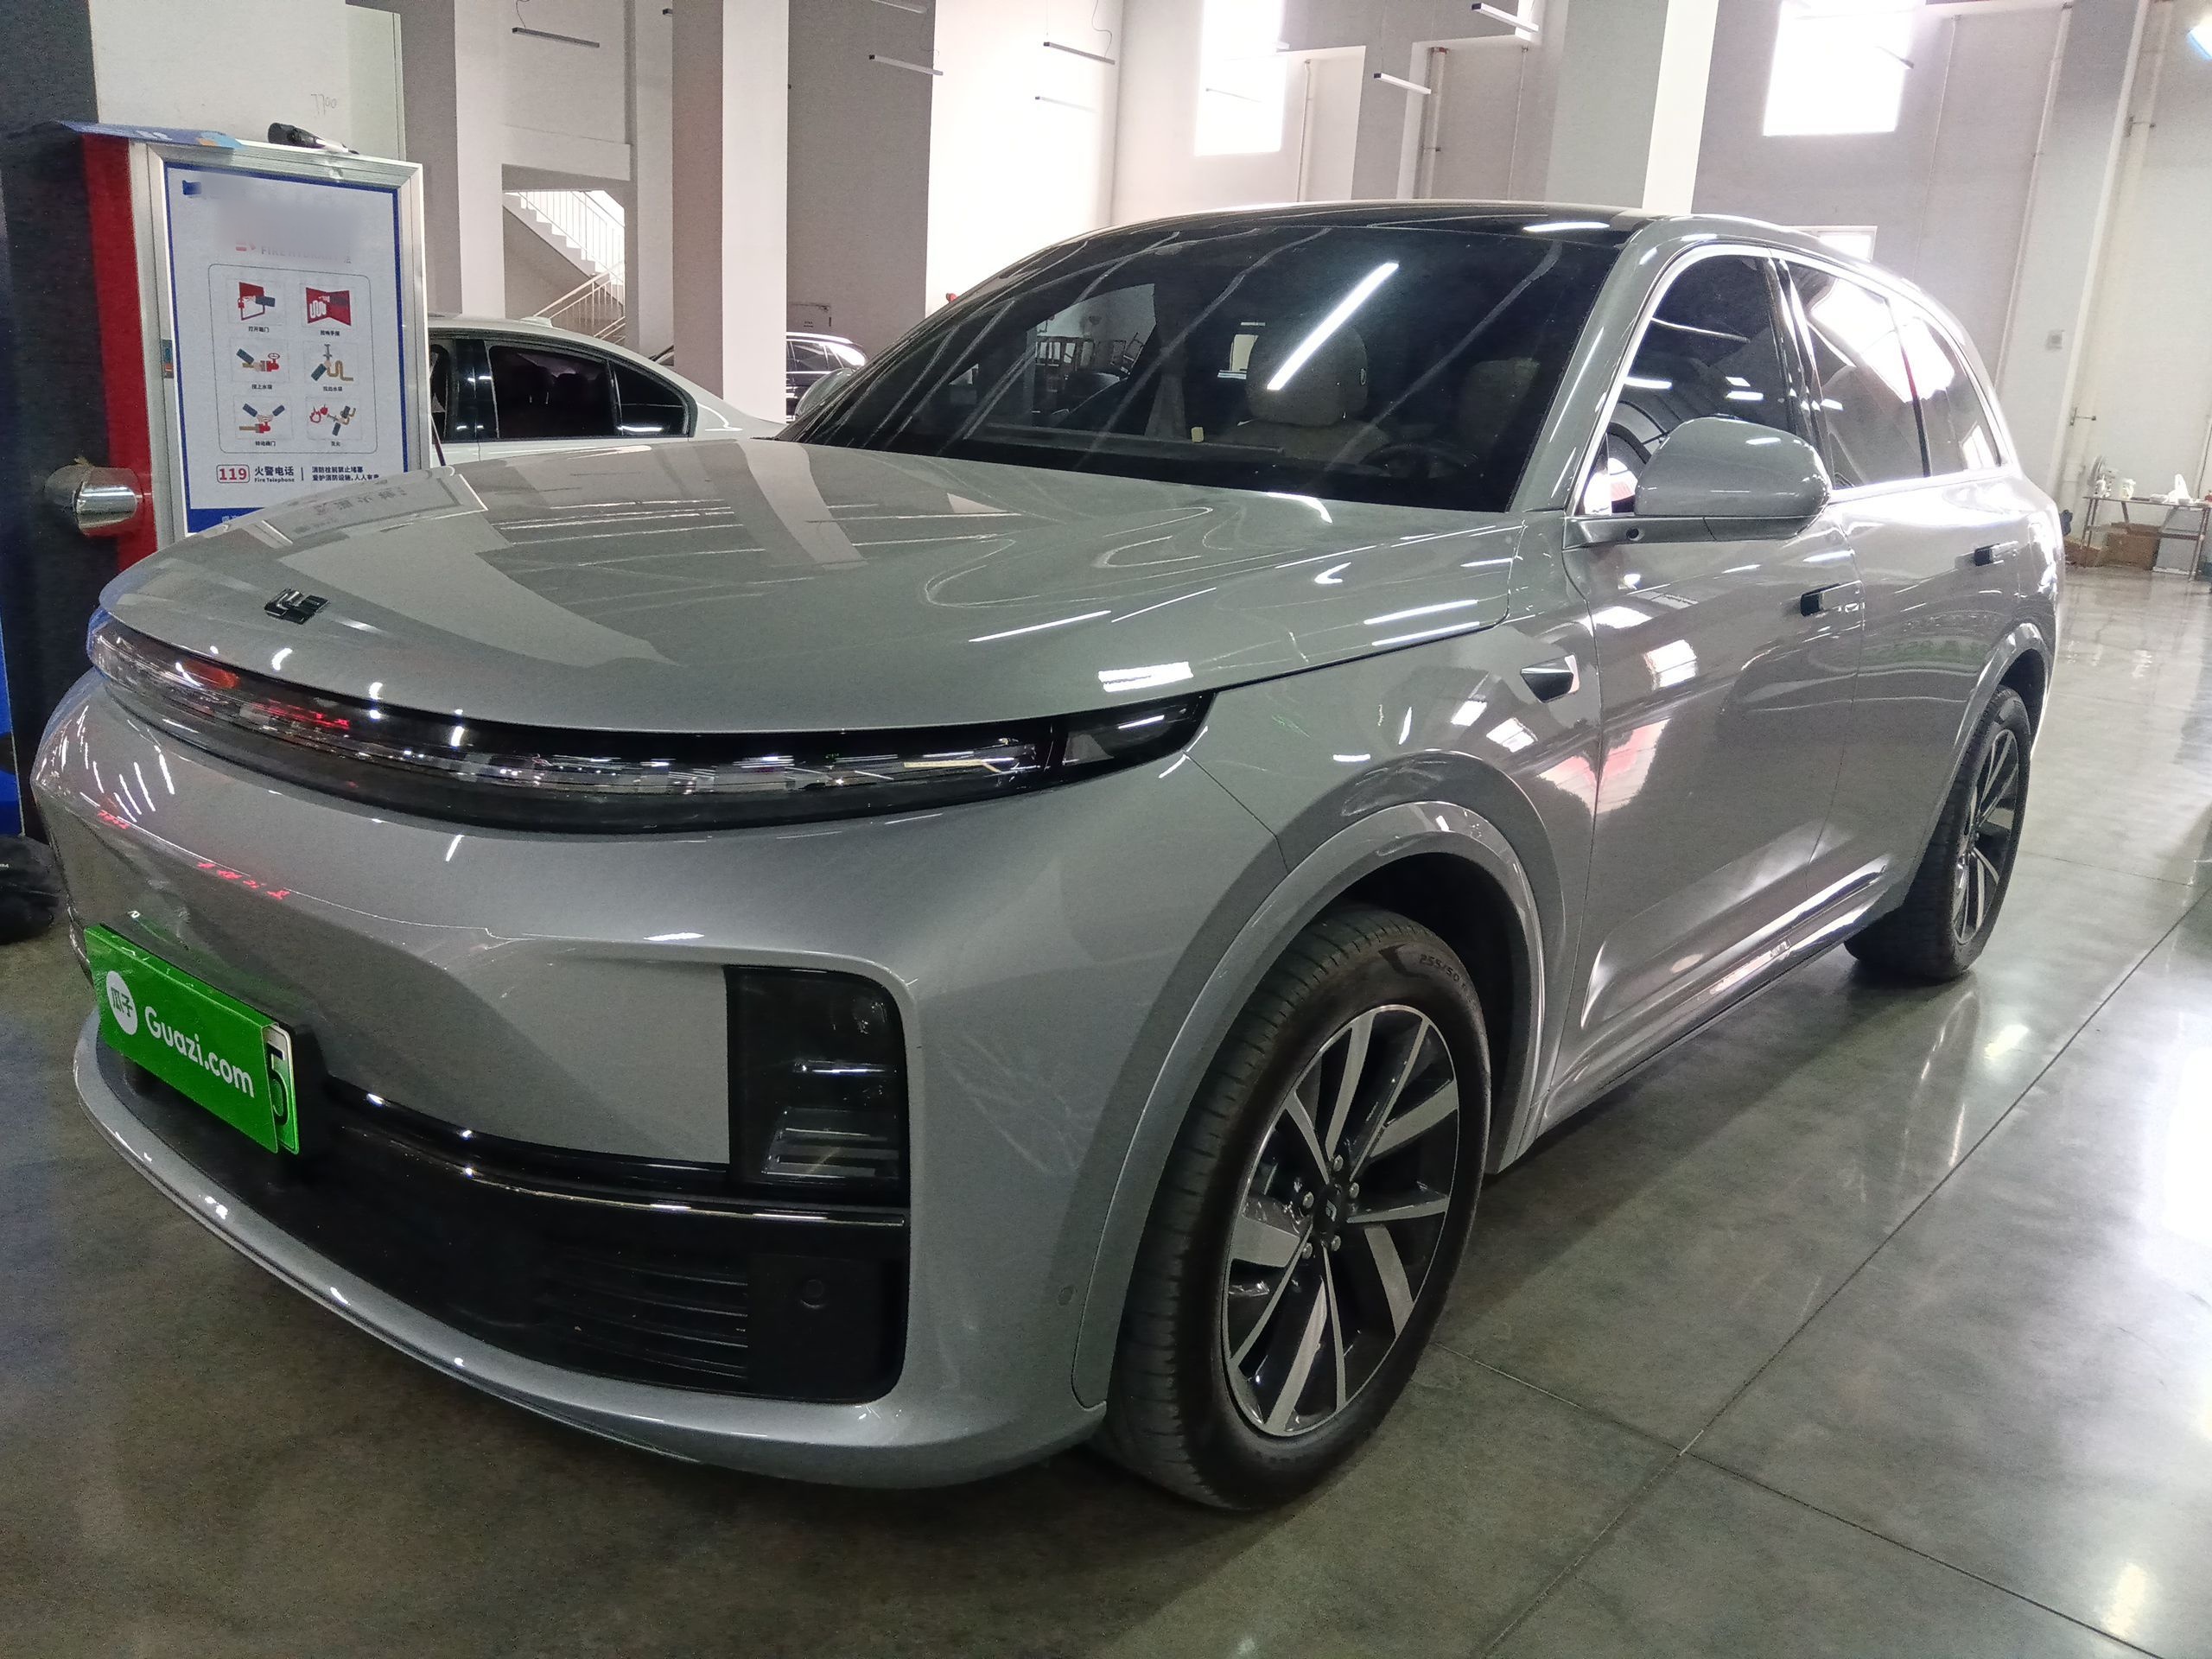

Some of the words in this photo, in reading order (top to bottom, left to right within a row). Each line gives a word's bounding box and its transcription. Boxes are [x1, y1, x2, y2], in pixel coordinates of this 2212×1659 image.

[219, 467, 248, 480] 119
[254, 466, 295, 476] 火警电话
[144, 1006, 255, 1098] Guazi.com
